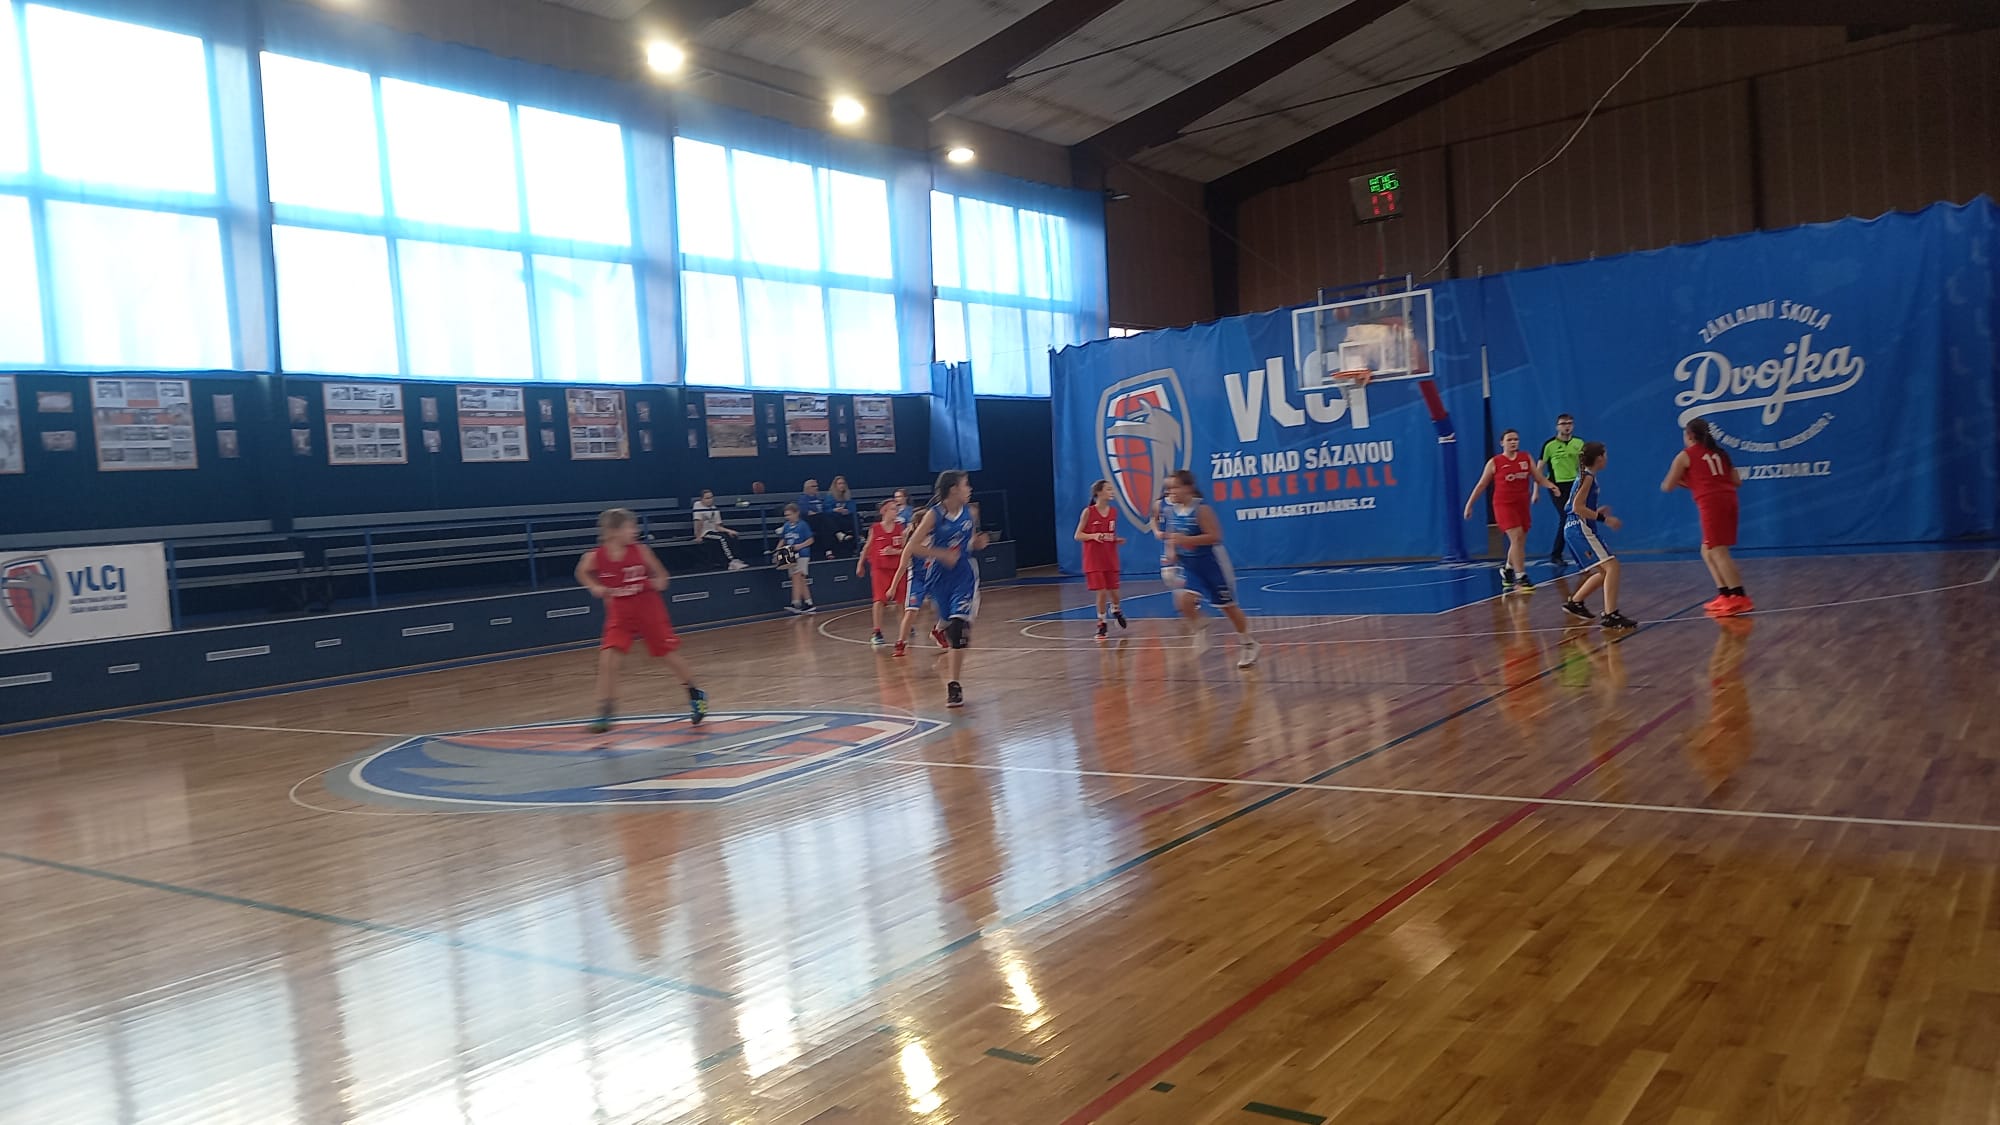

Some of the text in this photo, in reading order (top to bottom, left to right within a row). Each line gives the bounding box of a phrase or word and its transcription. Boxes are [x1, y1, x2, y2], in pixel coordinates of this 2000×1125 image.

[1698, 299, 1833, 344] ZÁKLADNÍ ŠKOLA
[1674, 334, 1865, 428] Dvojka
[1211, 440, 1394, 480] ŽĎÁR NAD SÁZAVOU
[1701, 453, 1725, 476] 11
[1213, 463, 1398, 502] BASKETBALL
[65, 564, 126, 596] VLCI
